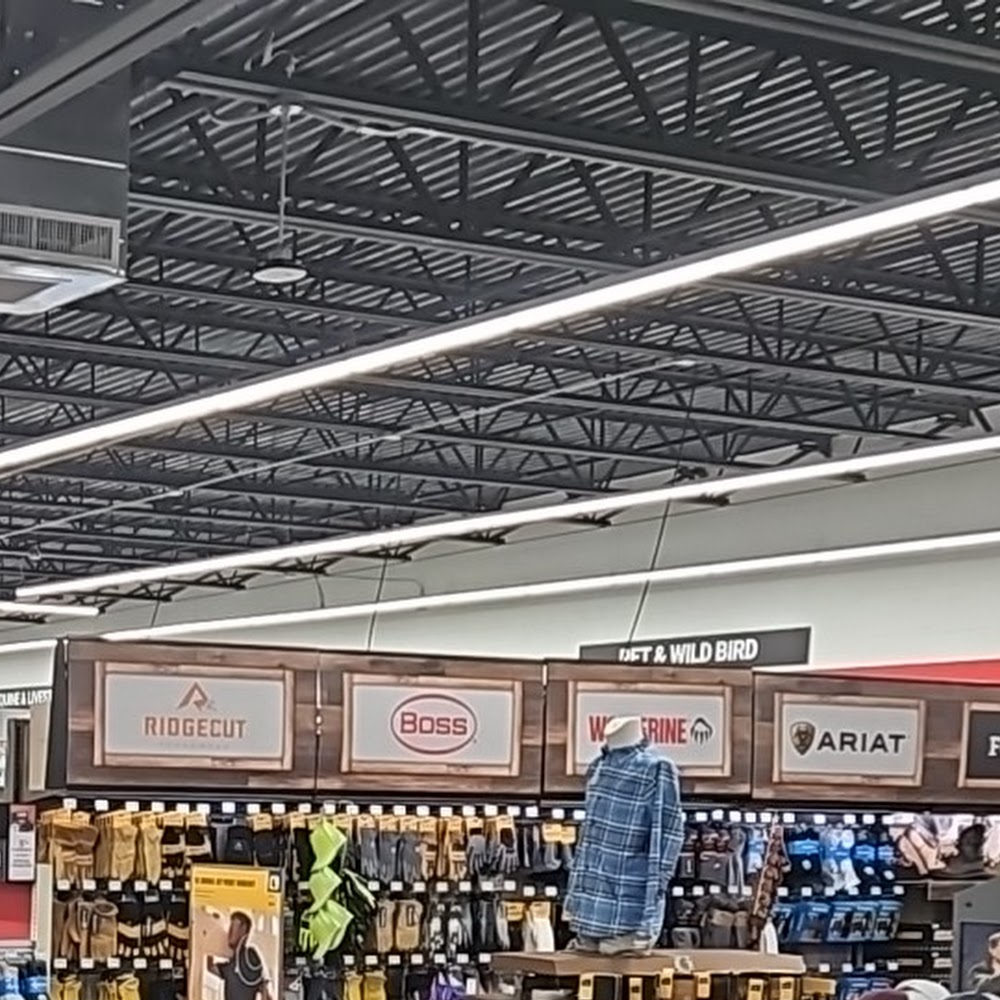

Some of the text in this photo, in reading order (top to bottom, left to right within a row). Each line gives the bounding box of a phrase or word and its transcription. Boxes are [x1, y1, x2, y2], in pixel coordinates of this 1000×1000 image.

[654, 646, 667, 662] &
[669, 642, 713, 664] WILD
[715, 638, 759, 662] BIRD
[145, 716, 247, 739] RIDGECUT
[590, 716, 687, 744] WERINE
[817, 731, 906, 753] ARIAT
